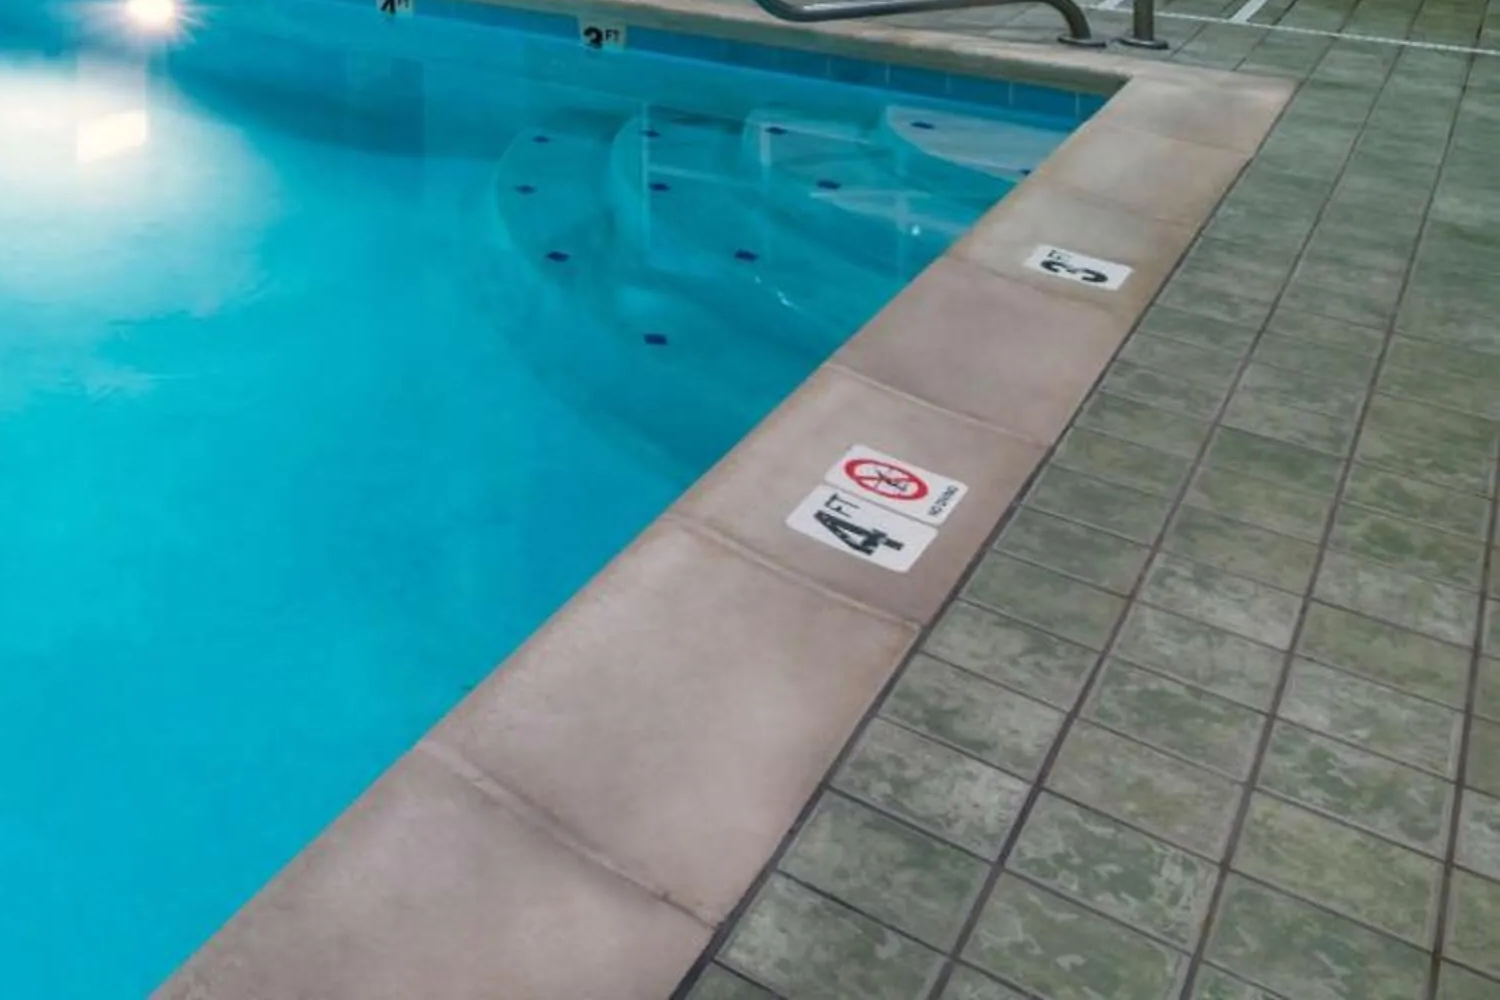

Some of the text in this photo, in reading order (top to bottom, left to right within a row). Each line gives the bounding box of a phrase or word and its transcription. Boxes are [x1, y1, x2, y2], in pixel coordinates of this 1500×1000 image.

[1041, 259, 1108, 283] 3
[813, 491, 905, 557] 4 FT
